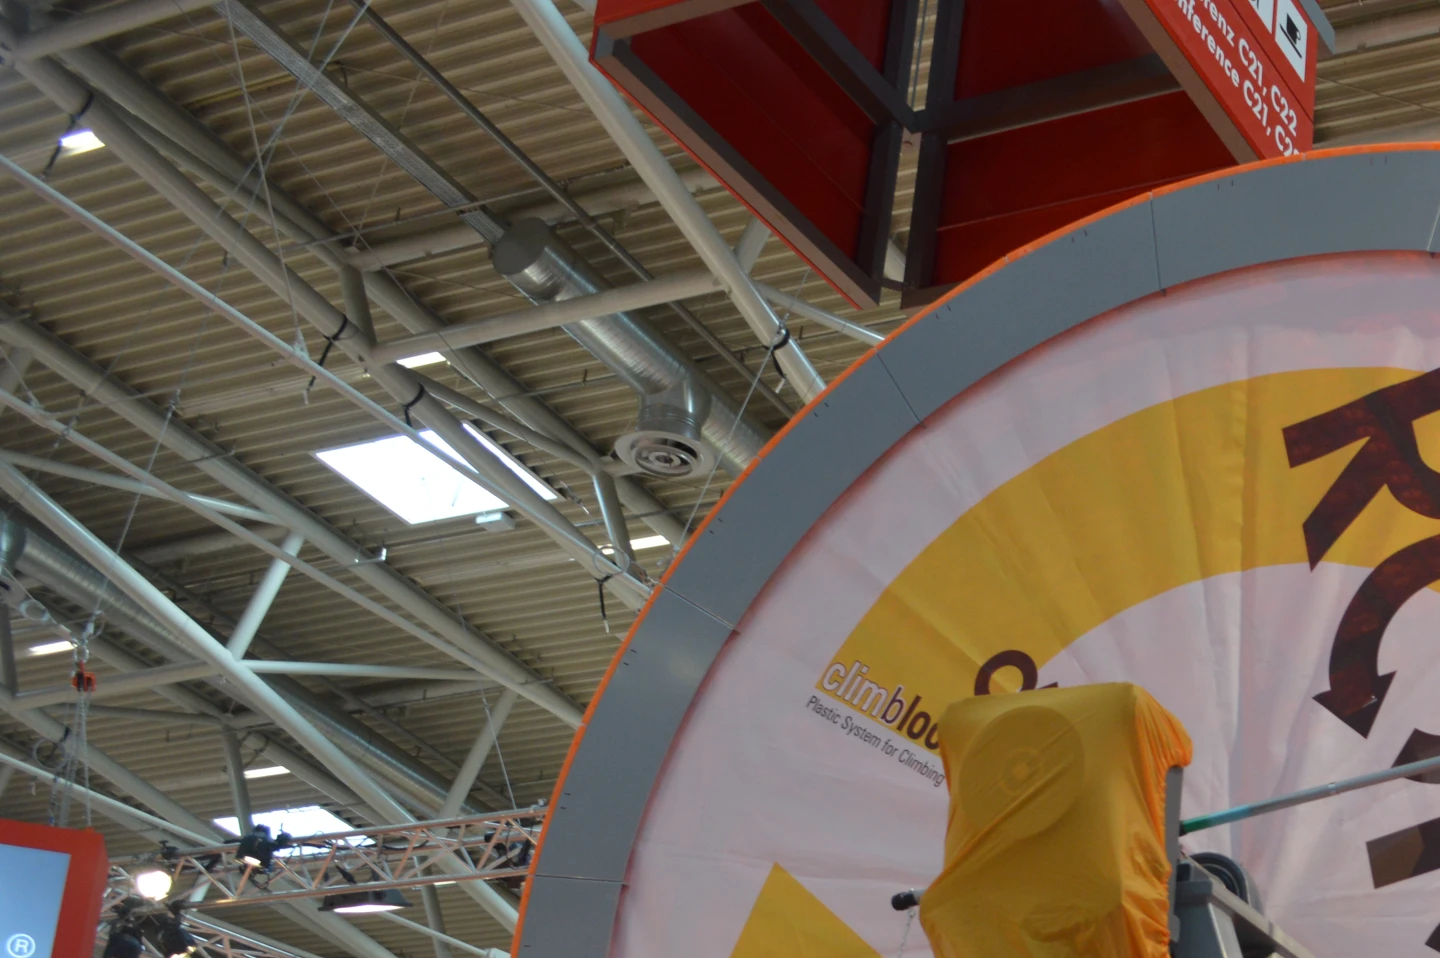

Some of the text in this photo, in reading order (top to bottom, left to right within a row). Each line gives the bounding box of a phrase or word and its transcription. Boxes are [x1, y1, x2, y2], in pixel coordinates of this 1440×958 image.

[1238, 38, 1268, 96] C21,
[1271, 84, 1298, 137] C22
[1243, 80, 1271, 136] C21,
[1275, 125, 1300, 157] C2
[805, 695, 946, 787] Plastic System for Climbing
